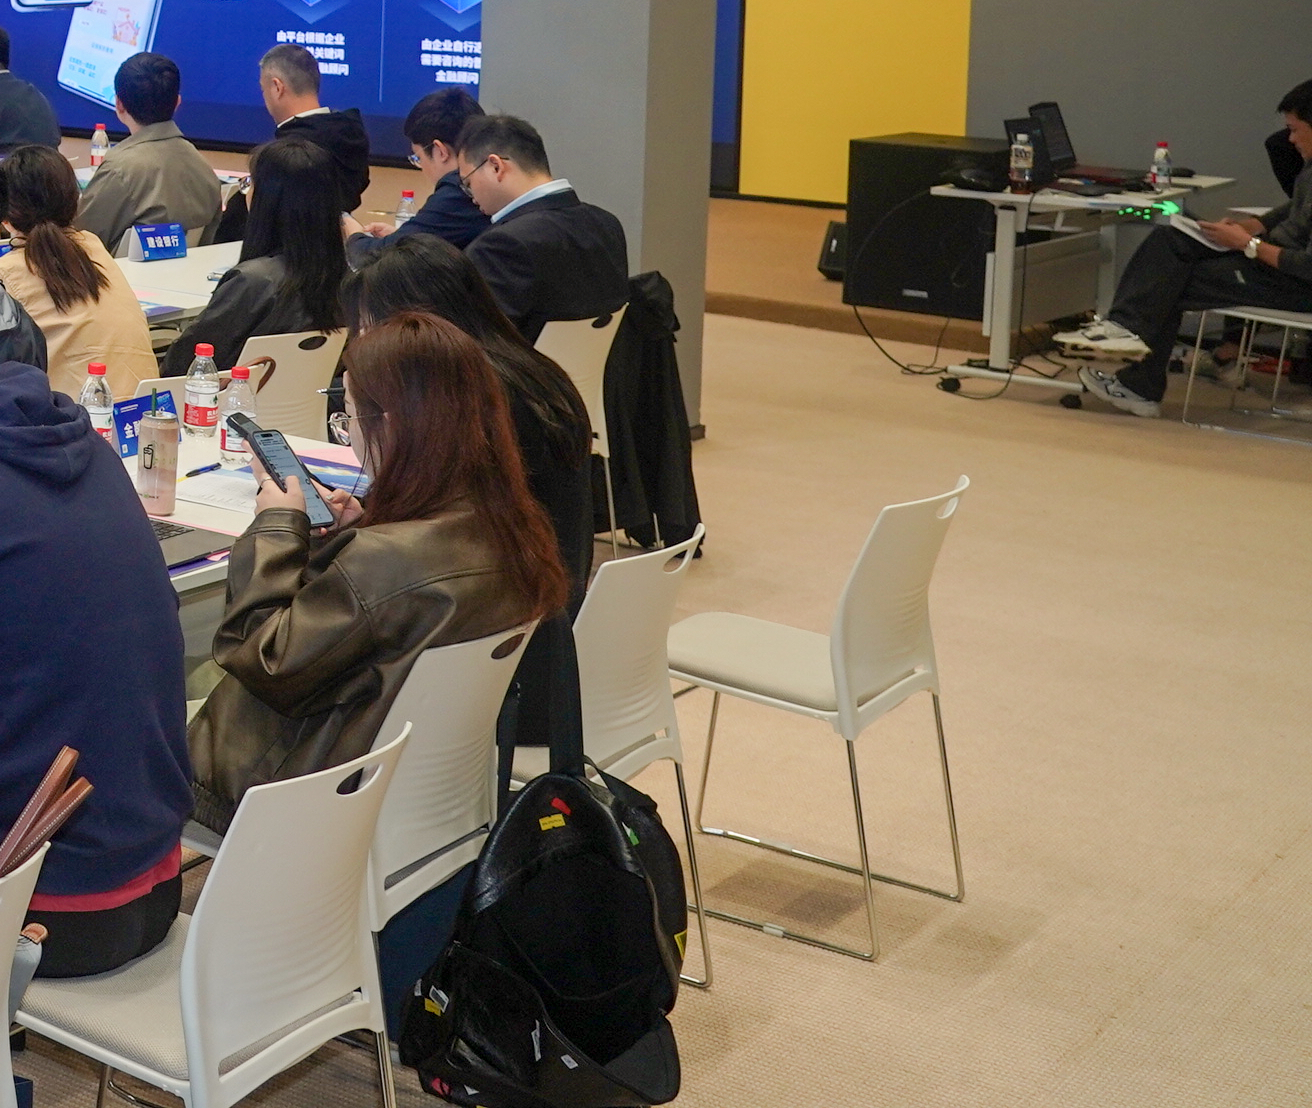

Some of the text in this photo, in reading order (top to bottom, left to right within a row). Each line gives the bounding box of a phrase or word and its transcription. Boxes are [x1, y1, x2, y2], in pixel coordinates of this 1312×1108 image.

[276, 30, 345, 46] 由平台根据企业
[146, 235, 180, 249] 建设银行
